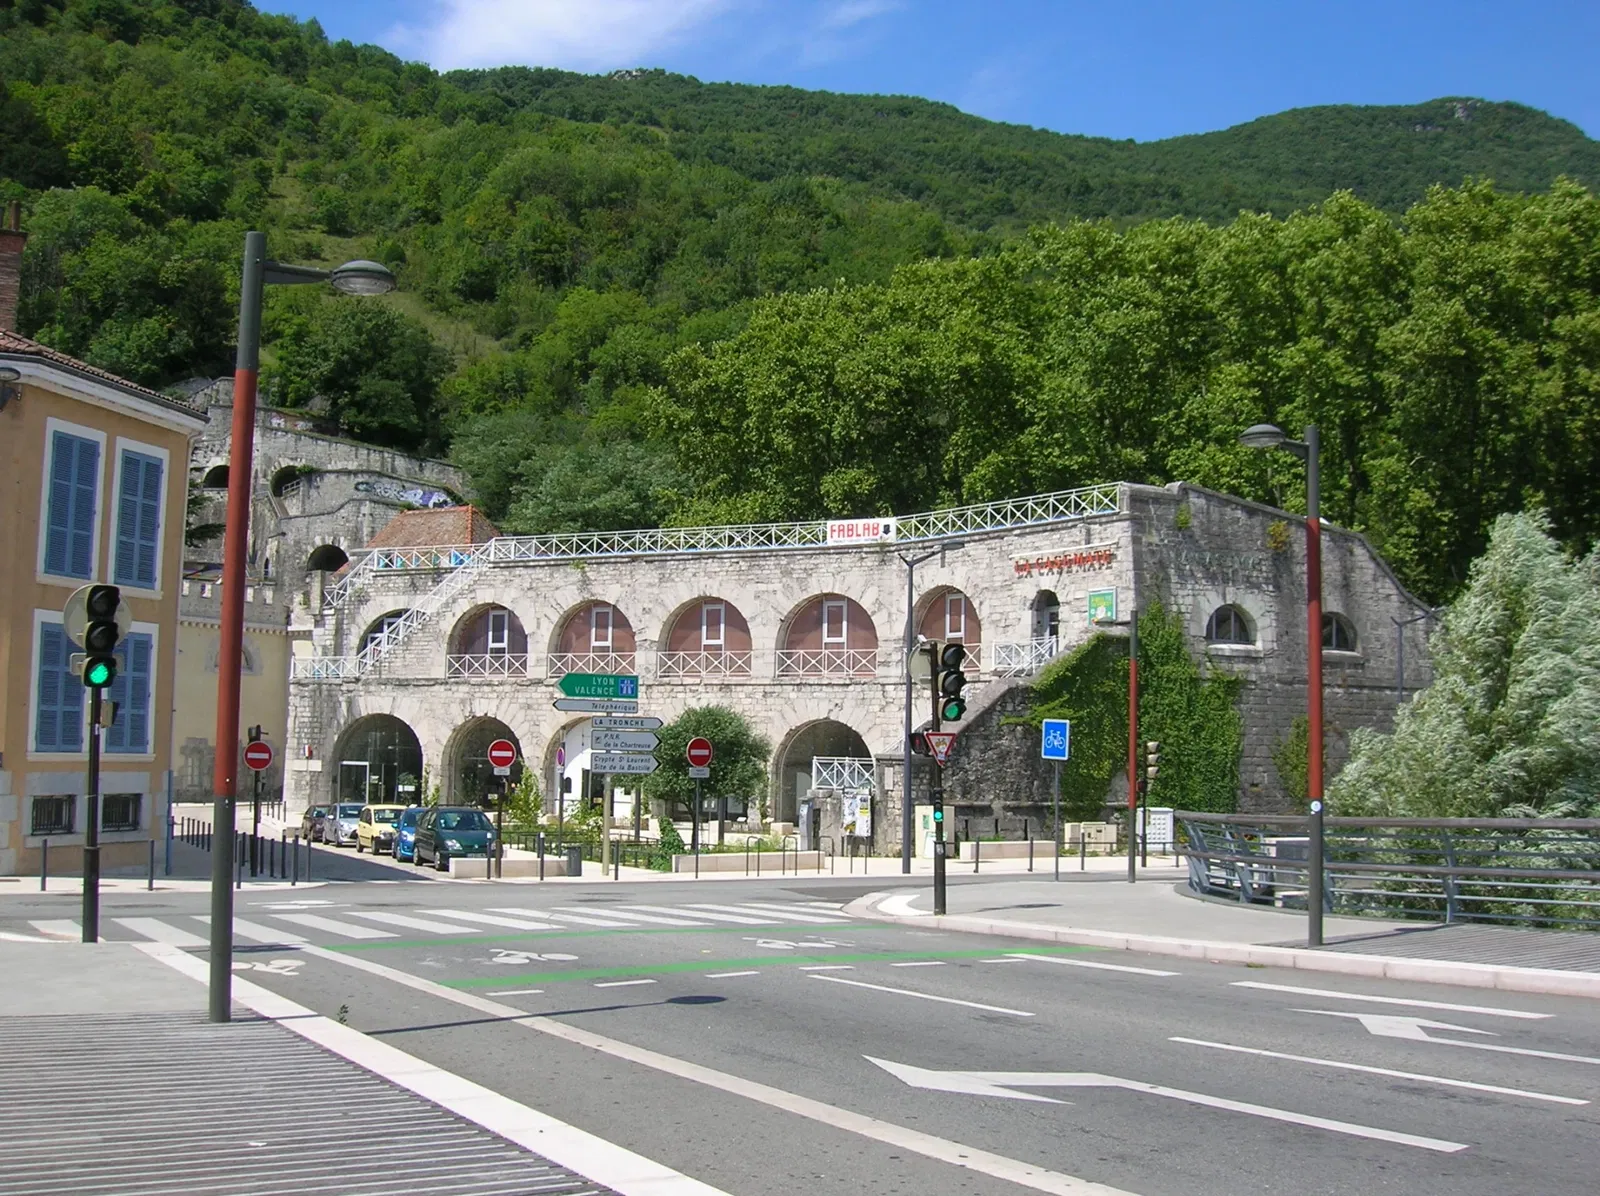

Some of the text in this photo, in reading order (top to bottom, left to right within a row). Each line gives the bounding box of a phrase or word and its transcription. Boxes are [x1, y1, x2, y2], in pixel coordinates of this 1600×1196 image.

[830, 523, 880, 539] FABLAB
[1014, 549, 1113, 574] LA CASEMATE
[592, 676, 615, 686] LYON
[574, 686, 615, 696] VALENCE
[608, 719, 645, 727] TRONCHE
[603, 741, 612, 749] de
[619, 741, 652, 750] Chartreuse
[593, 755, 616, 764] Crypte
[626, 756, 651, 764] Laurent
